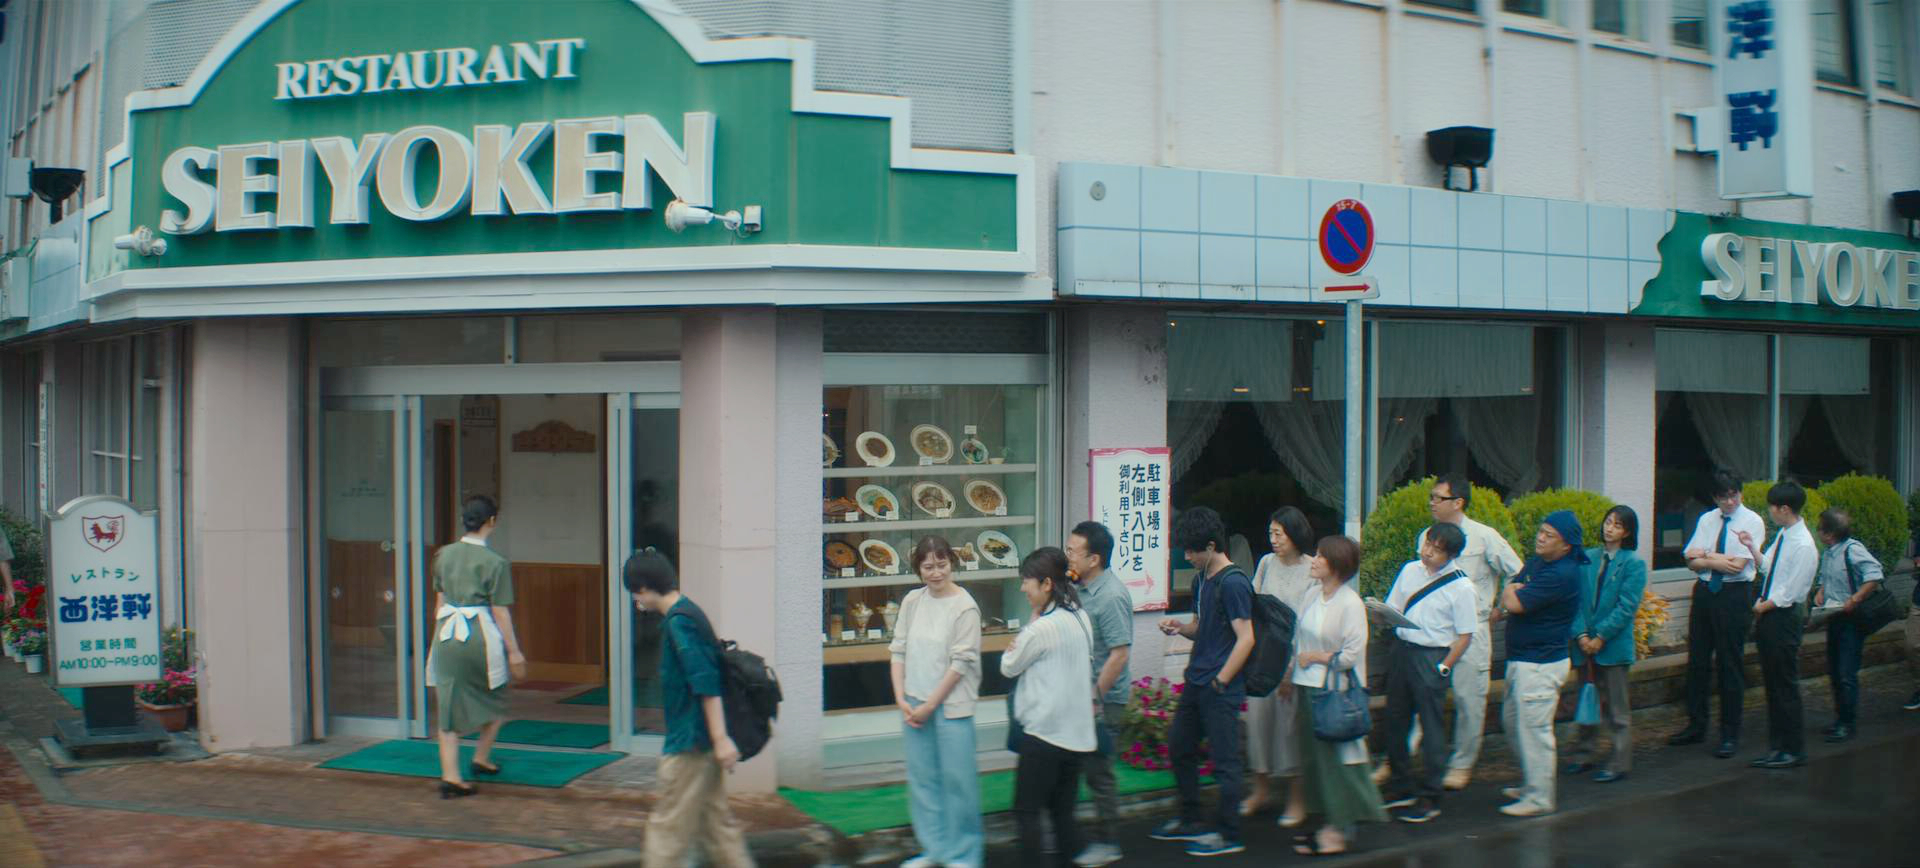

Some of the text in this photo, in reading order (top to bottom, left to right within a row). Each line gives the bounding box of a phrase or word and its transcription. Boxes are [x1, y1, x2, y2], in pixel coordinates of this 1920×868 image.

[274, 38, 585, 101] RESTAURANT
[160, 111, 716, 236] SEIYOKEN
[1131, 464, 1145, 571] 左側入口を
[1147, 463, 1160, 549] 駐車場は
[71, 567, 140, 584] レストラン
[80, 637, 137, 652] 営業時間
